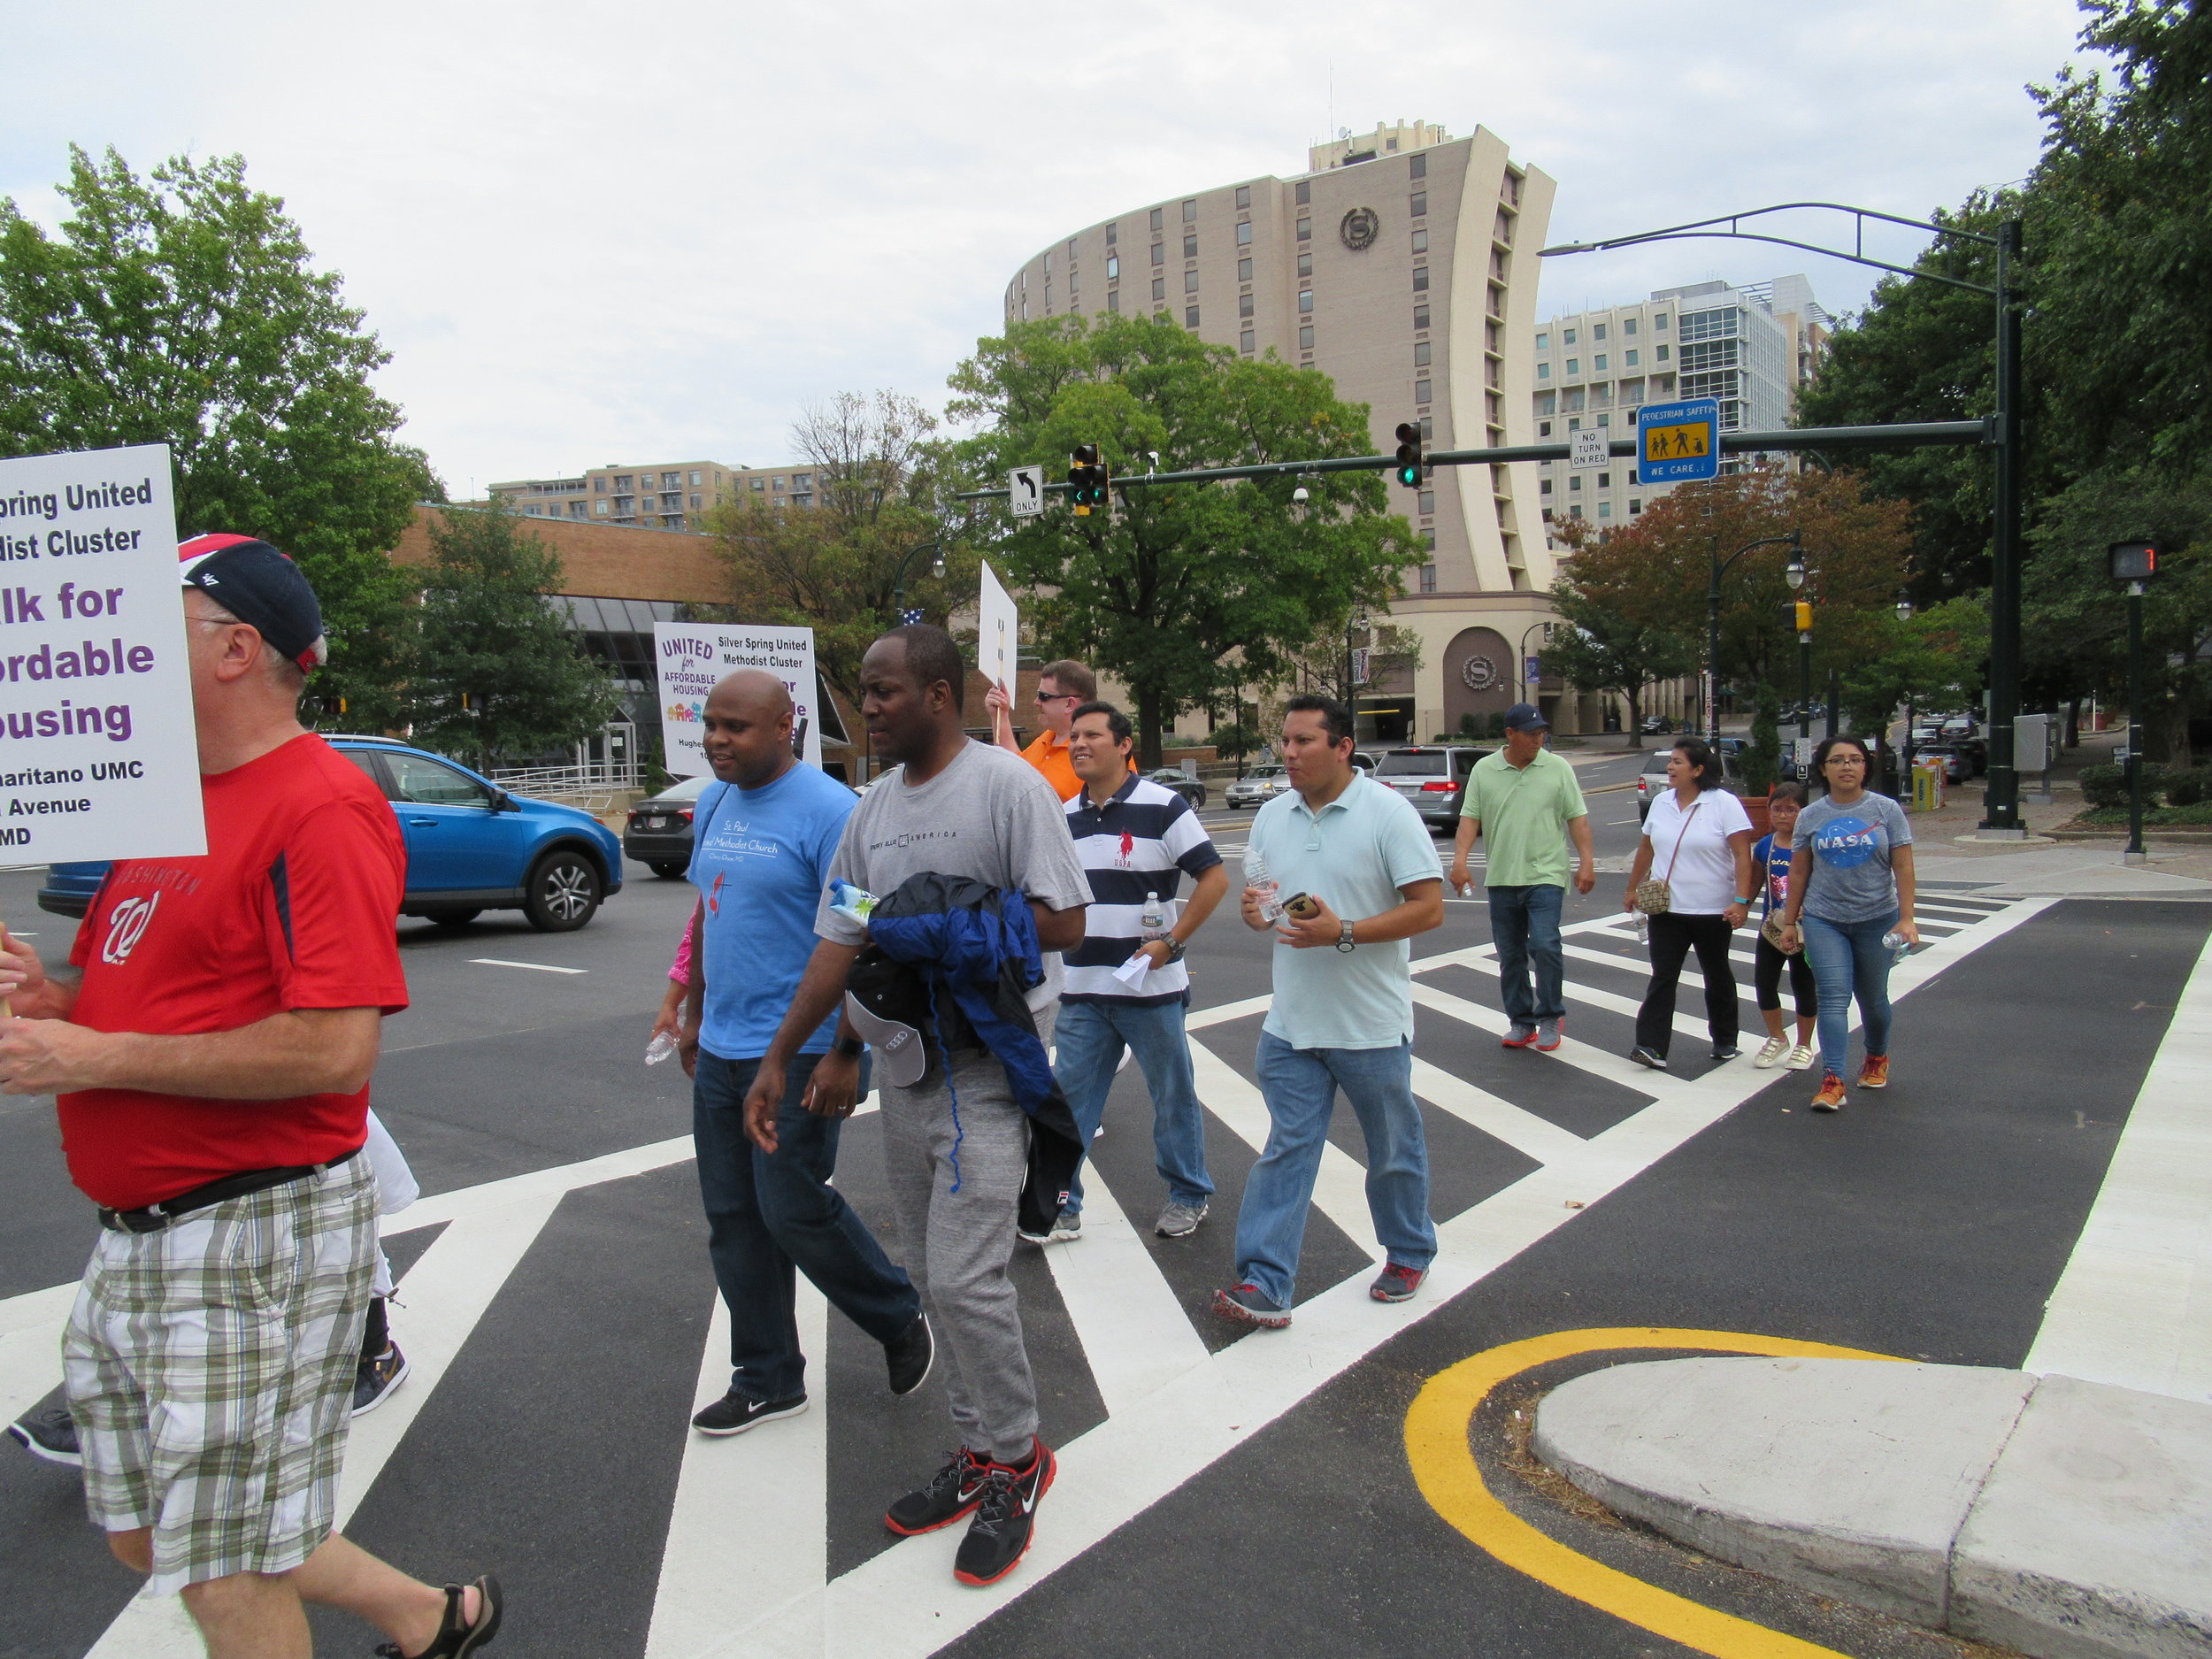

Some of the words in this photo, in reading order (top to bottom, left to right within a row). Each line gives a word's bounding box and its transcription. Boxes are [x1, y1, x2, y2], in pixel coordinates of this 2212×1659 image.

[1641, 409, 1684, 421] PEDESTRIAN
[1686, 406, 1713, 416] SAFETY
[1578, 444, 1601, 453] TURN
[1588, 454, 1606, 463] RED
[1651, 467, 1663, 476] WE
[65, 478, 152, 511] United
[1016, 500, 1038, 511] ONLY
[47, 526, 142, 557] Cluster
[58, 582, 124, 618] for
[662, 637, 713, 660] UNITED
[718, 636, 743, 648] Silver
[745, 637, 774, 652] Spring
[776, 639, 807, 650] United
[0, 638, 154, 682] rdable
[681, 655, 695, 672] for
[723, 654, 767, 666] Methodist
[770, 656, 803, 668] Cluster
[664, 672, 716, 684] AFFORDABLE
[672, 684, 709, 696] HOUSING
[0, 700, 132, 741] using
[0, 768, 83, 787] aritano
[91, 760, 144, 780] UMC
[9, 798, 91, 816] Avenue
[733, 821, 749, 832] Paul
[0, 827, 31, 846] MD
[1817, 834, 1874, 849] NASA
[713, 837, 747, 849] Methodist
[749, 840, 779, 854] Church
[1114, 858, 1131, 868] USPA
